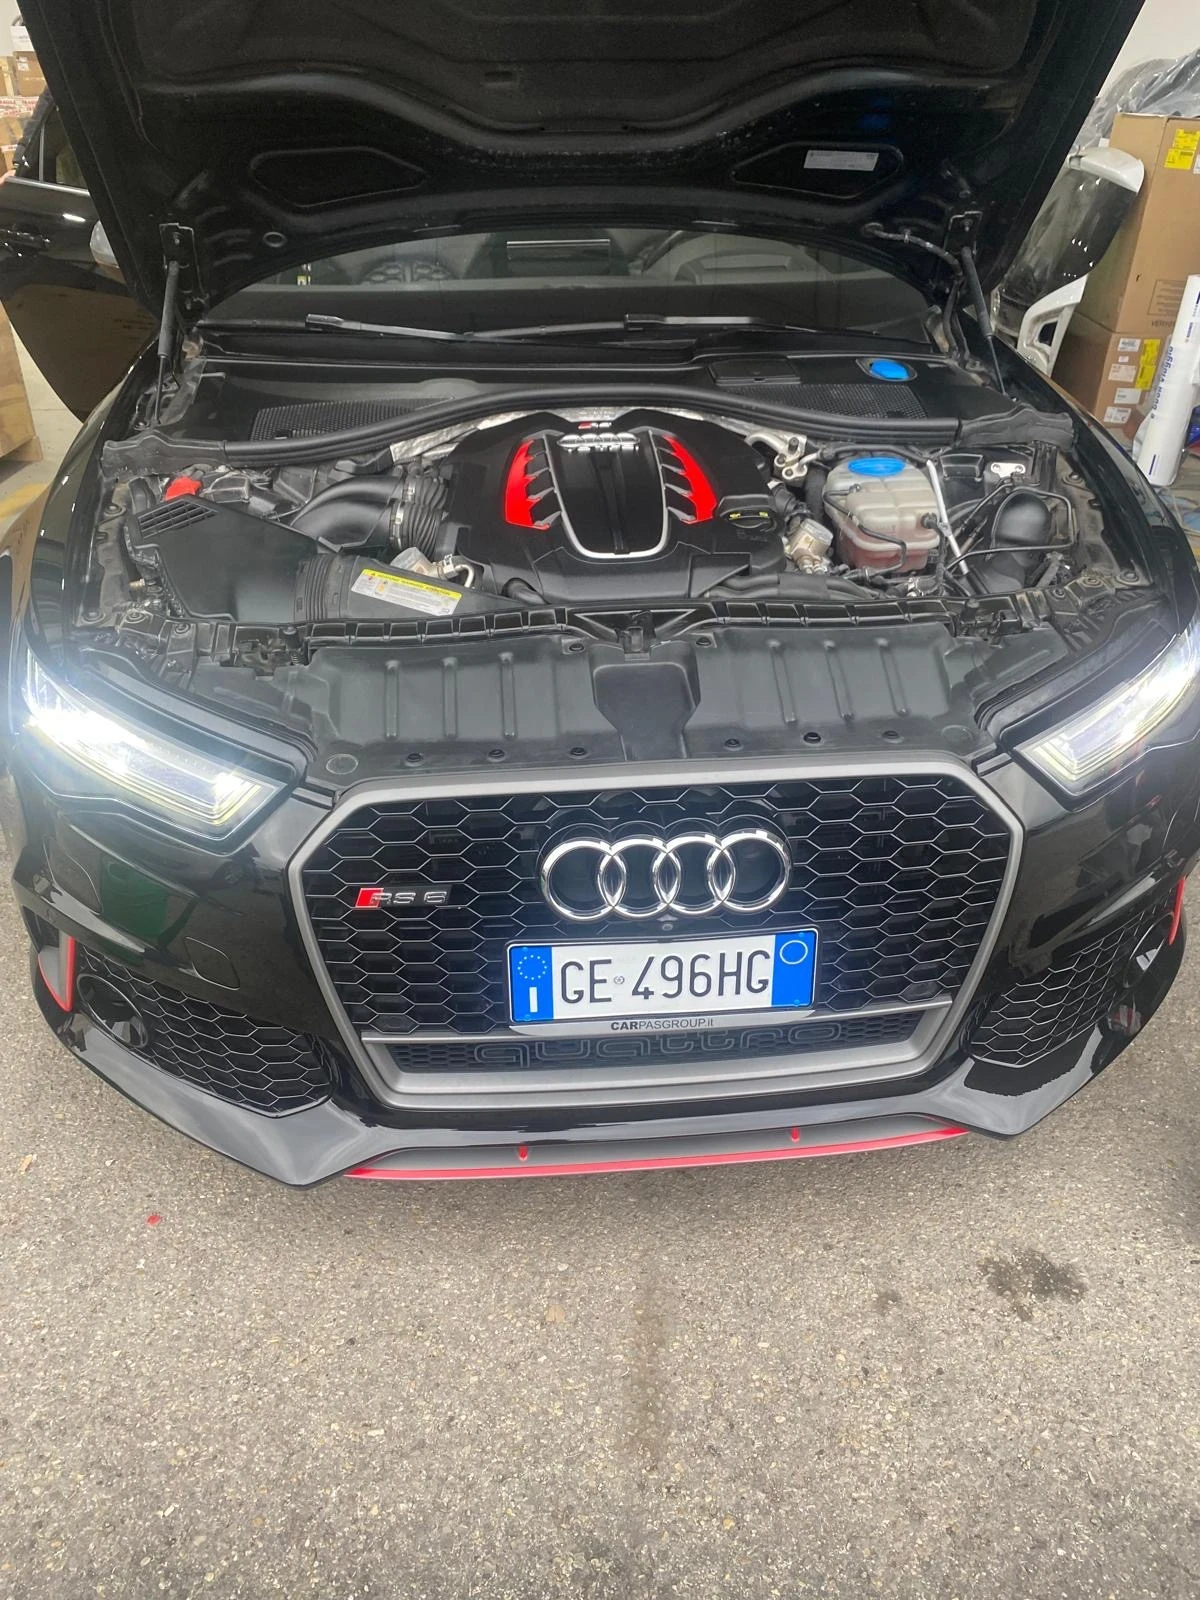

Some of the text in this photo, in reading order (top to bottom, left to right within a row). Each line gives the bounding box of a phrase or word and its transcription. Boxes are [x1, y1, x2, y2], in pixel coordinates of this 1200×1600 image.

[369, 890, 447, 905] RS 6
[560, 948, 771, 1005] GE 496HG
[610, 1017, 715, 1032] CARPASGROUP.it
[474, 1022, 842, 1070] quattro
